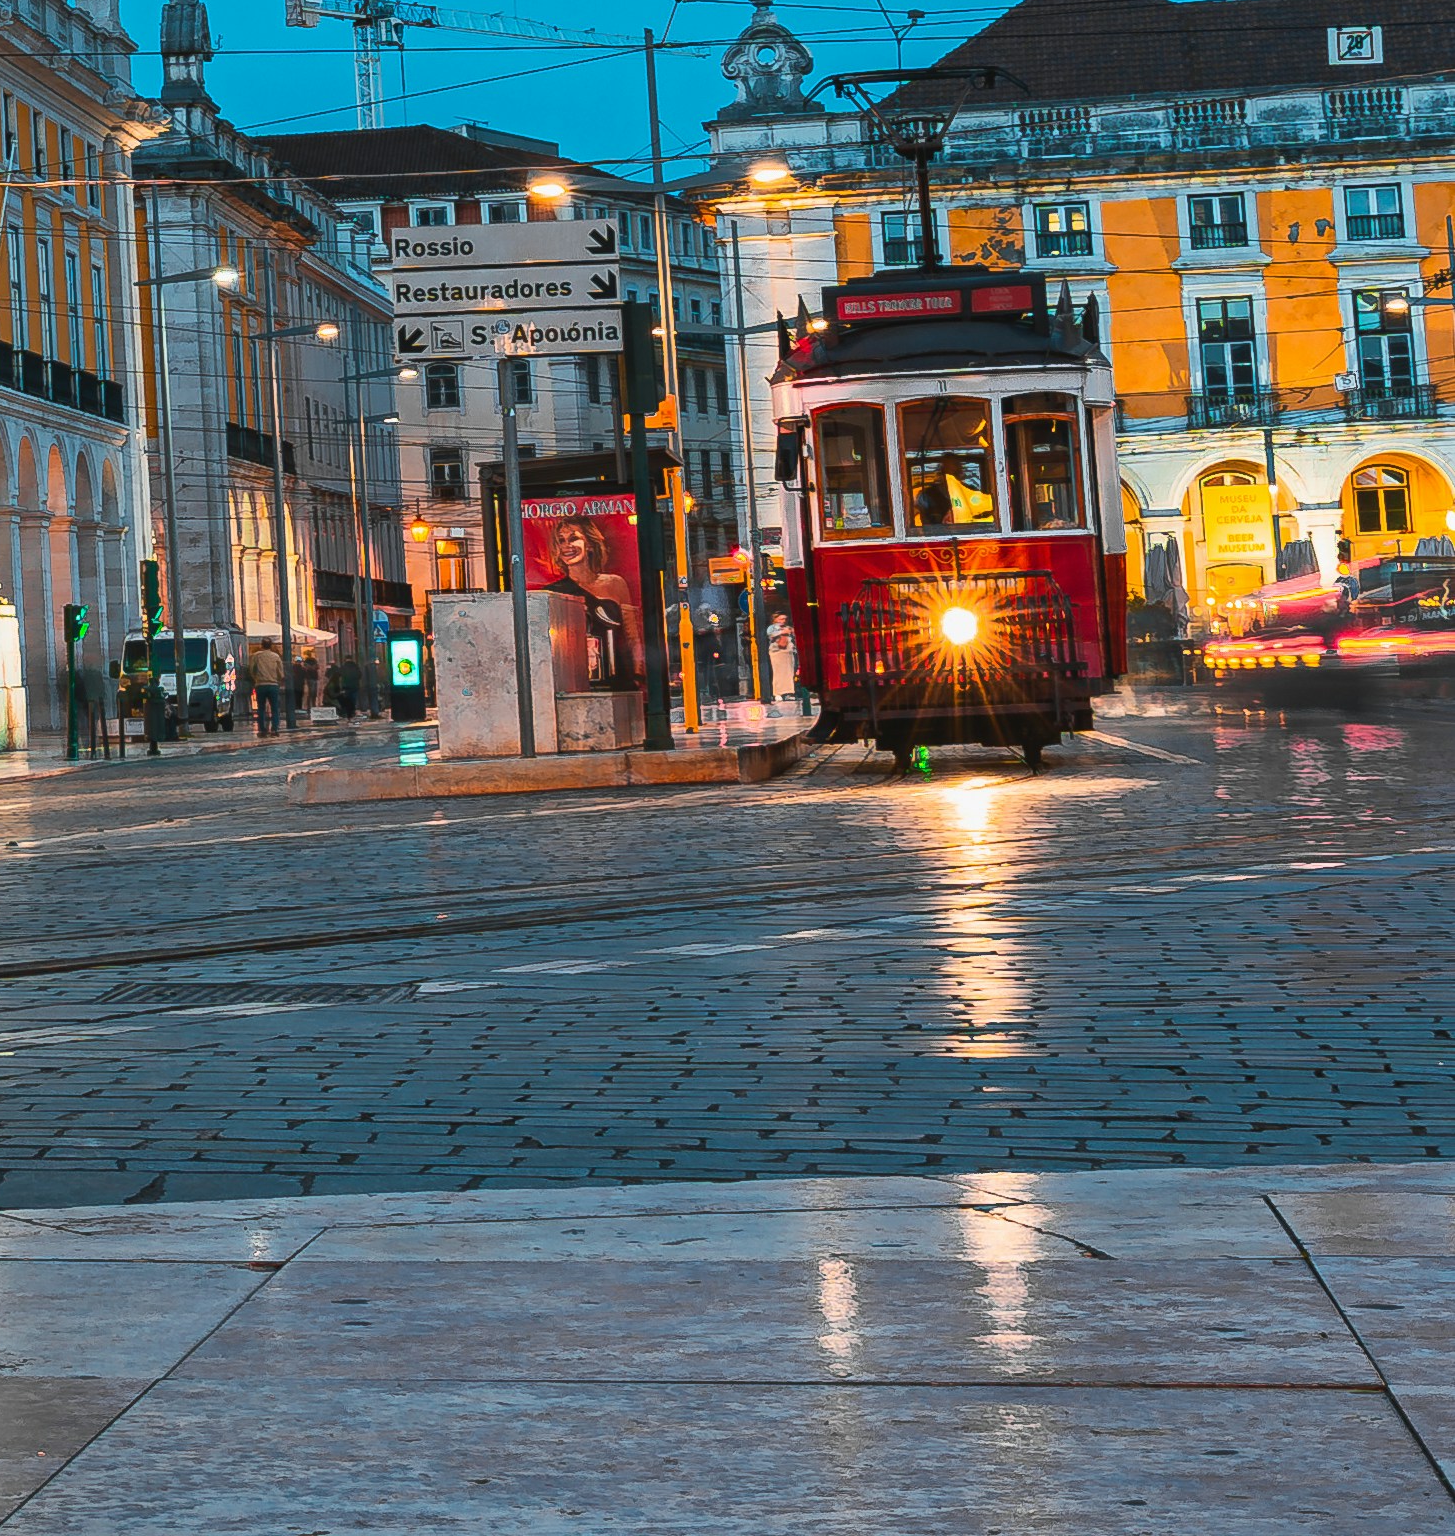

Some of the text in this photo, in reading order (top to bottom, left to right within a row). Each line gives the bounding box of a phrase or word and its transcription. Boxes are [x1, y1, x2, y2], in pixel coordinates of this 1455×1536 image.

[395, 236, 474, 257] Rossio
[395, 279, 572, 303] Restauradores
[1219, 494, 1257, 503] MUSEU
[582, 500, 636, 516] ARMAN
[1231, 505, 1247, 513] DA
[1216, 515, 1263, 524] CERVEJA
[1228, 533, 1254, 542] BEER
[1218, 543, 1265, 553] MUSEUM
